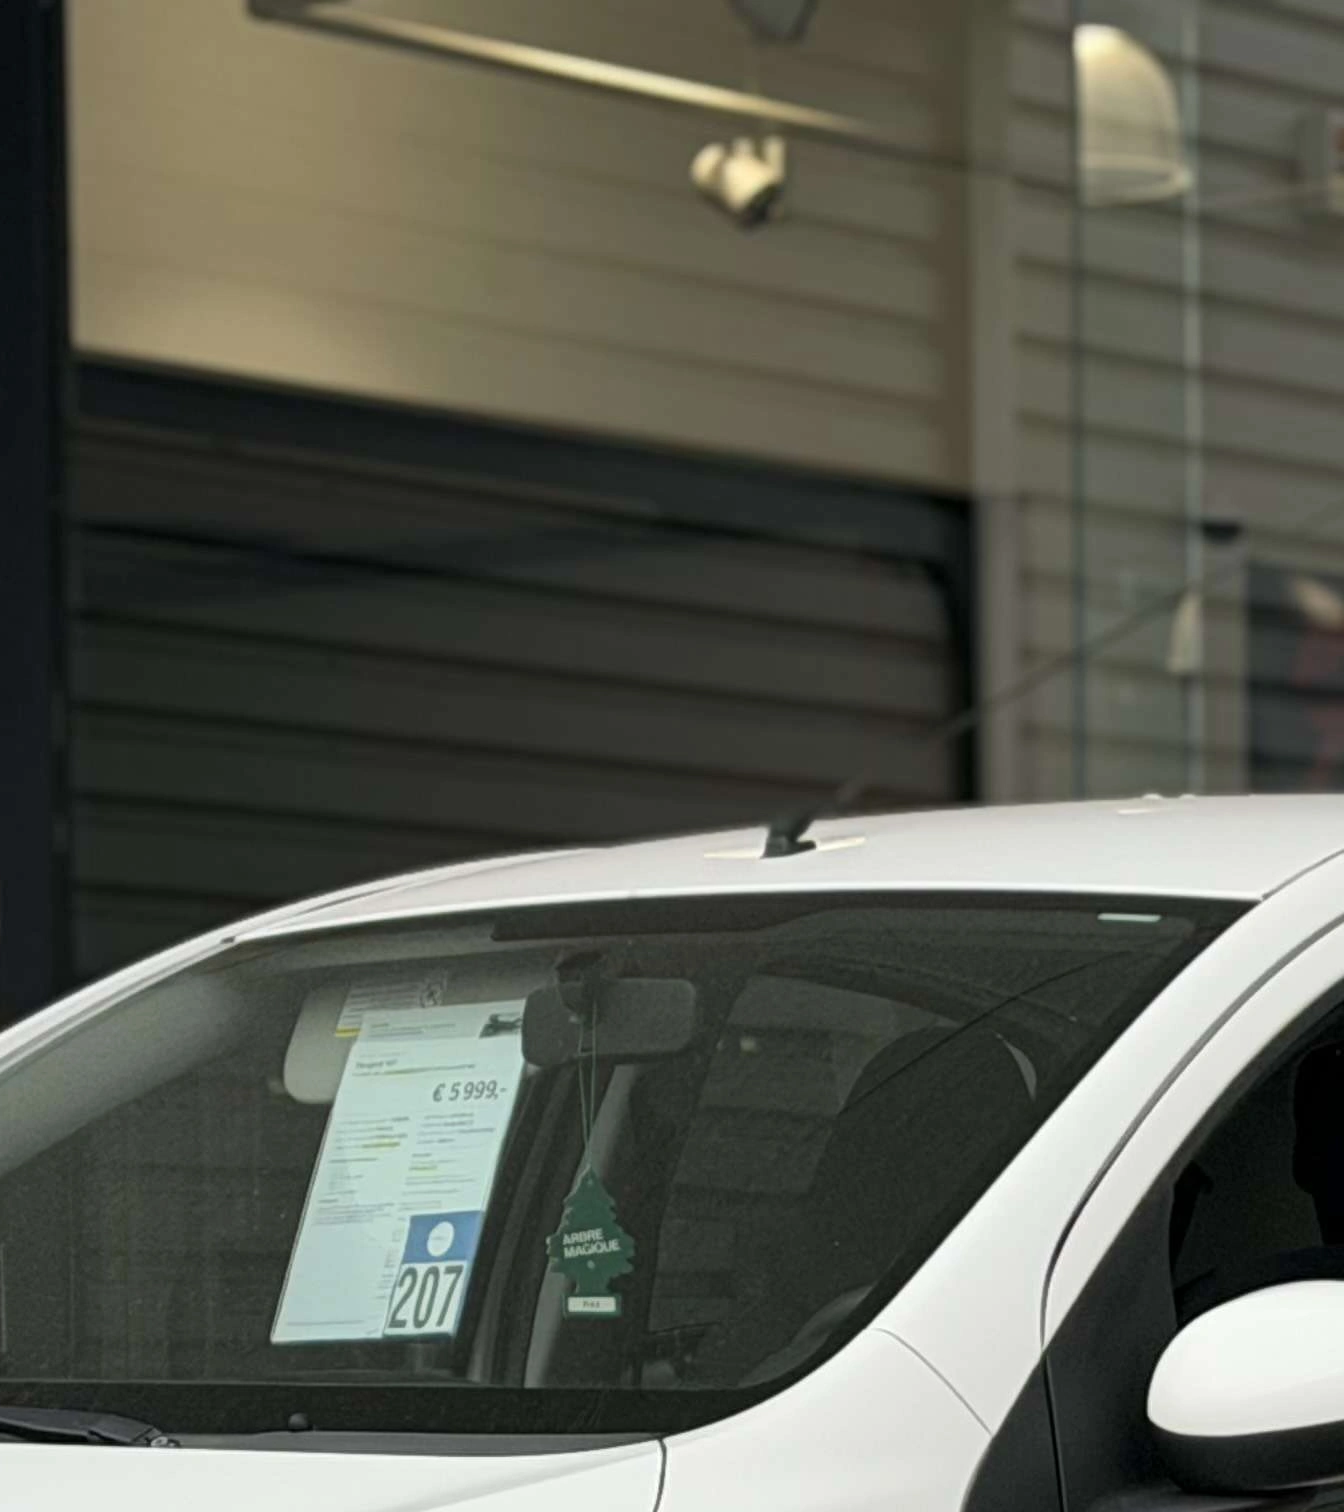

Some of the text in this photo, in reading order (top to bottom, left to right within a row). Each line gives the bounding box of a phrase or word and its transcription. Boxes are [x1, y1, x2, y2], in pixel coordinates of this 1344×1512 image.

[563, 1228, 603, 1245] ARBRE
[564, 1239, 620, 1259] MAGIQUE
[388, 1265, 464, 1328] 207
